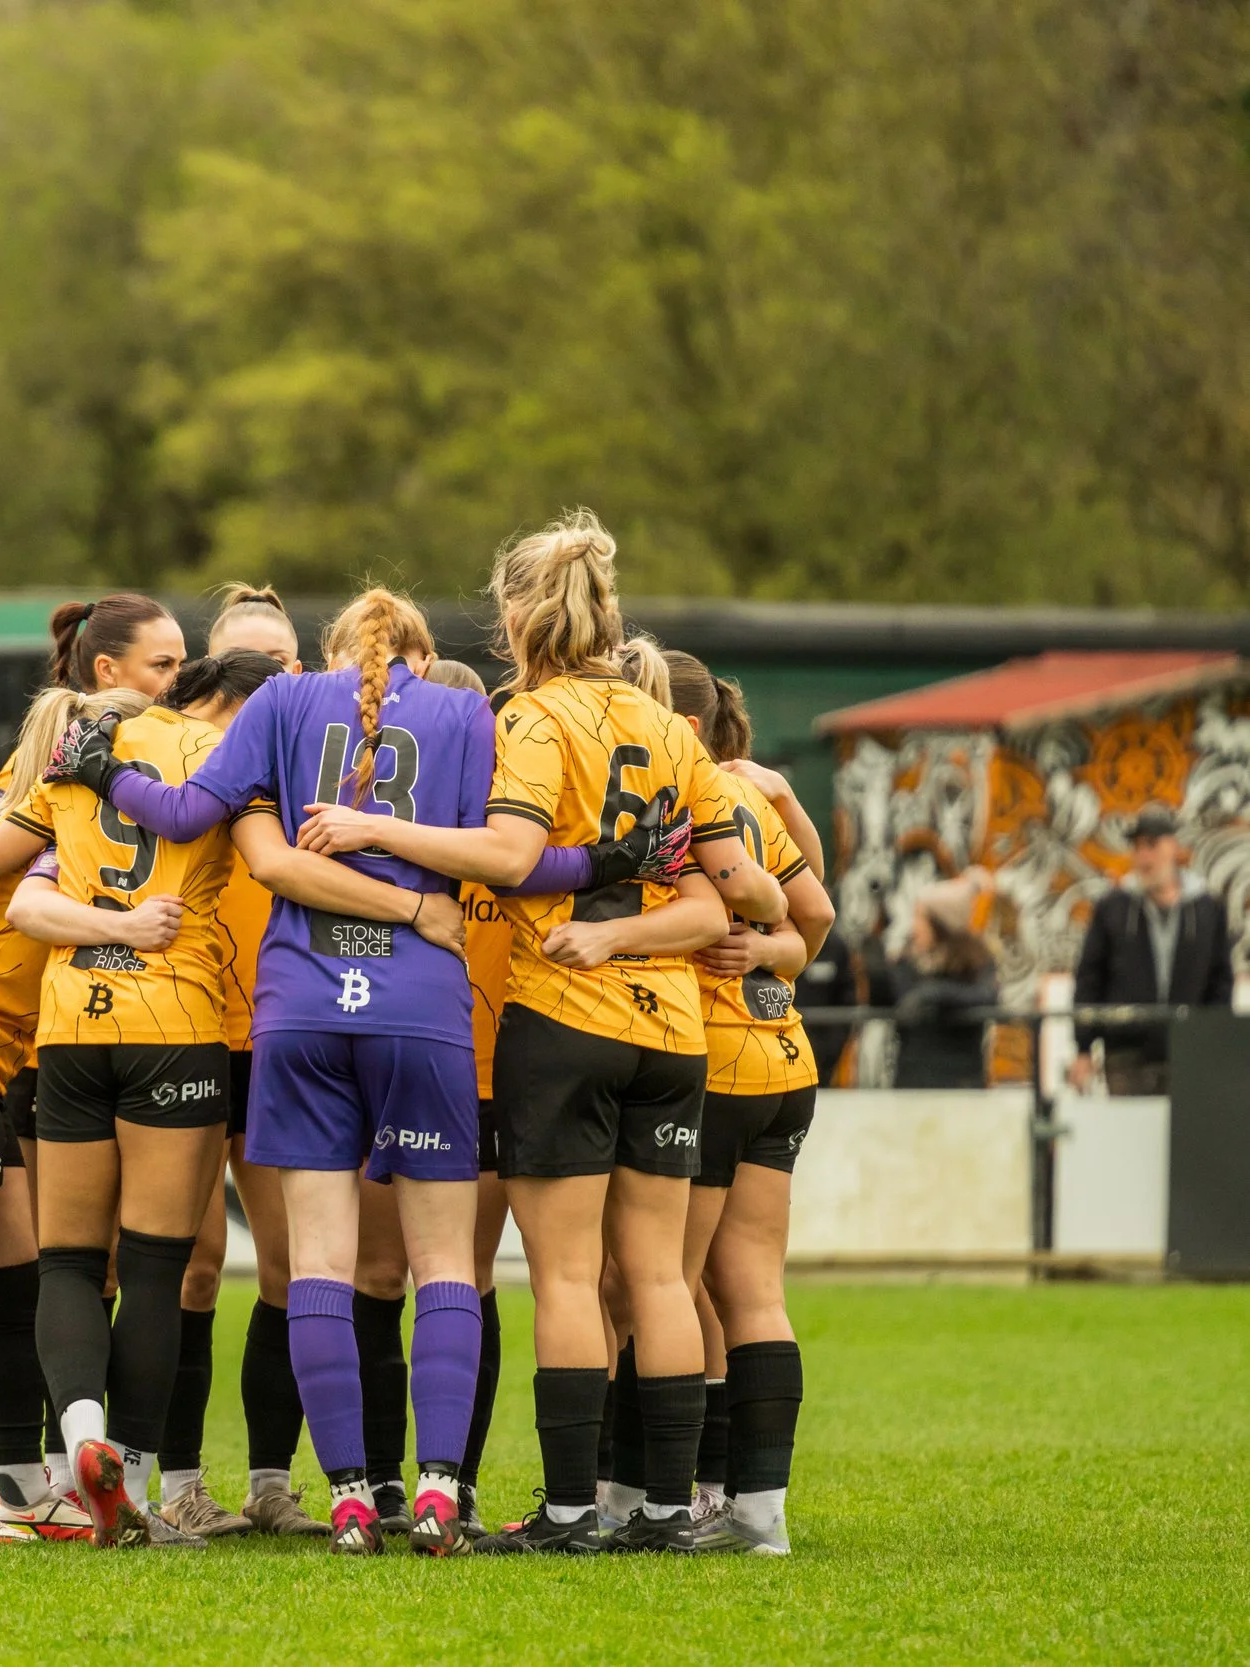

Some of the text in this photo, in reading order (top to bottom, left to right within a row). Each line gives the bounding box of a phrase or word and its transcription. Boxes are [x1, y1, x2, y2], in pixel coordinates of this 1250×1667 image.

[98, 758, 165, 892] 9
[332, 926, 391, 943] STONE
[339, 940, 392, 957] RIDGE
[757, 985, 792, 1004] STONE
[765, 1001, 791, 1019] RIDG
